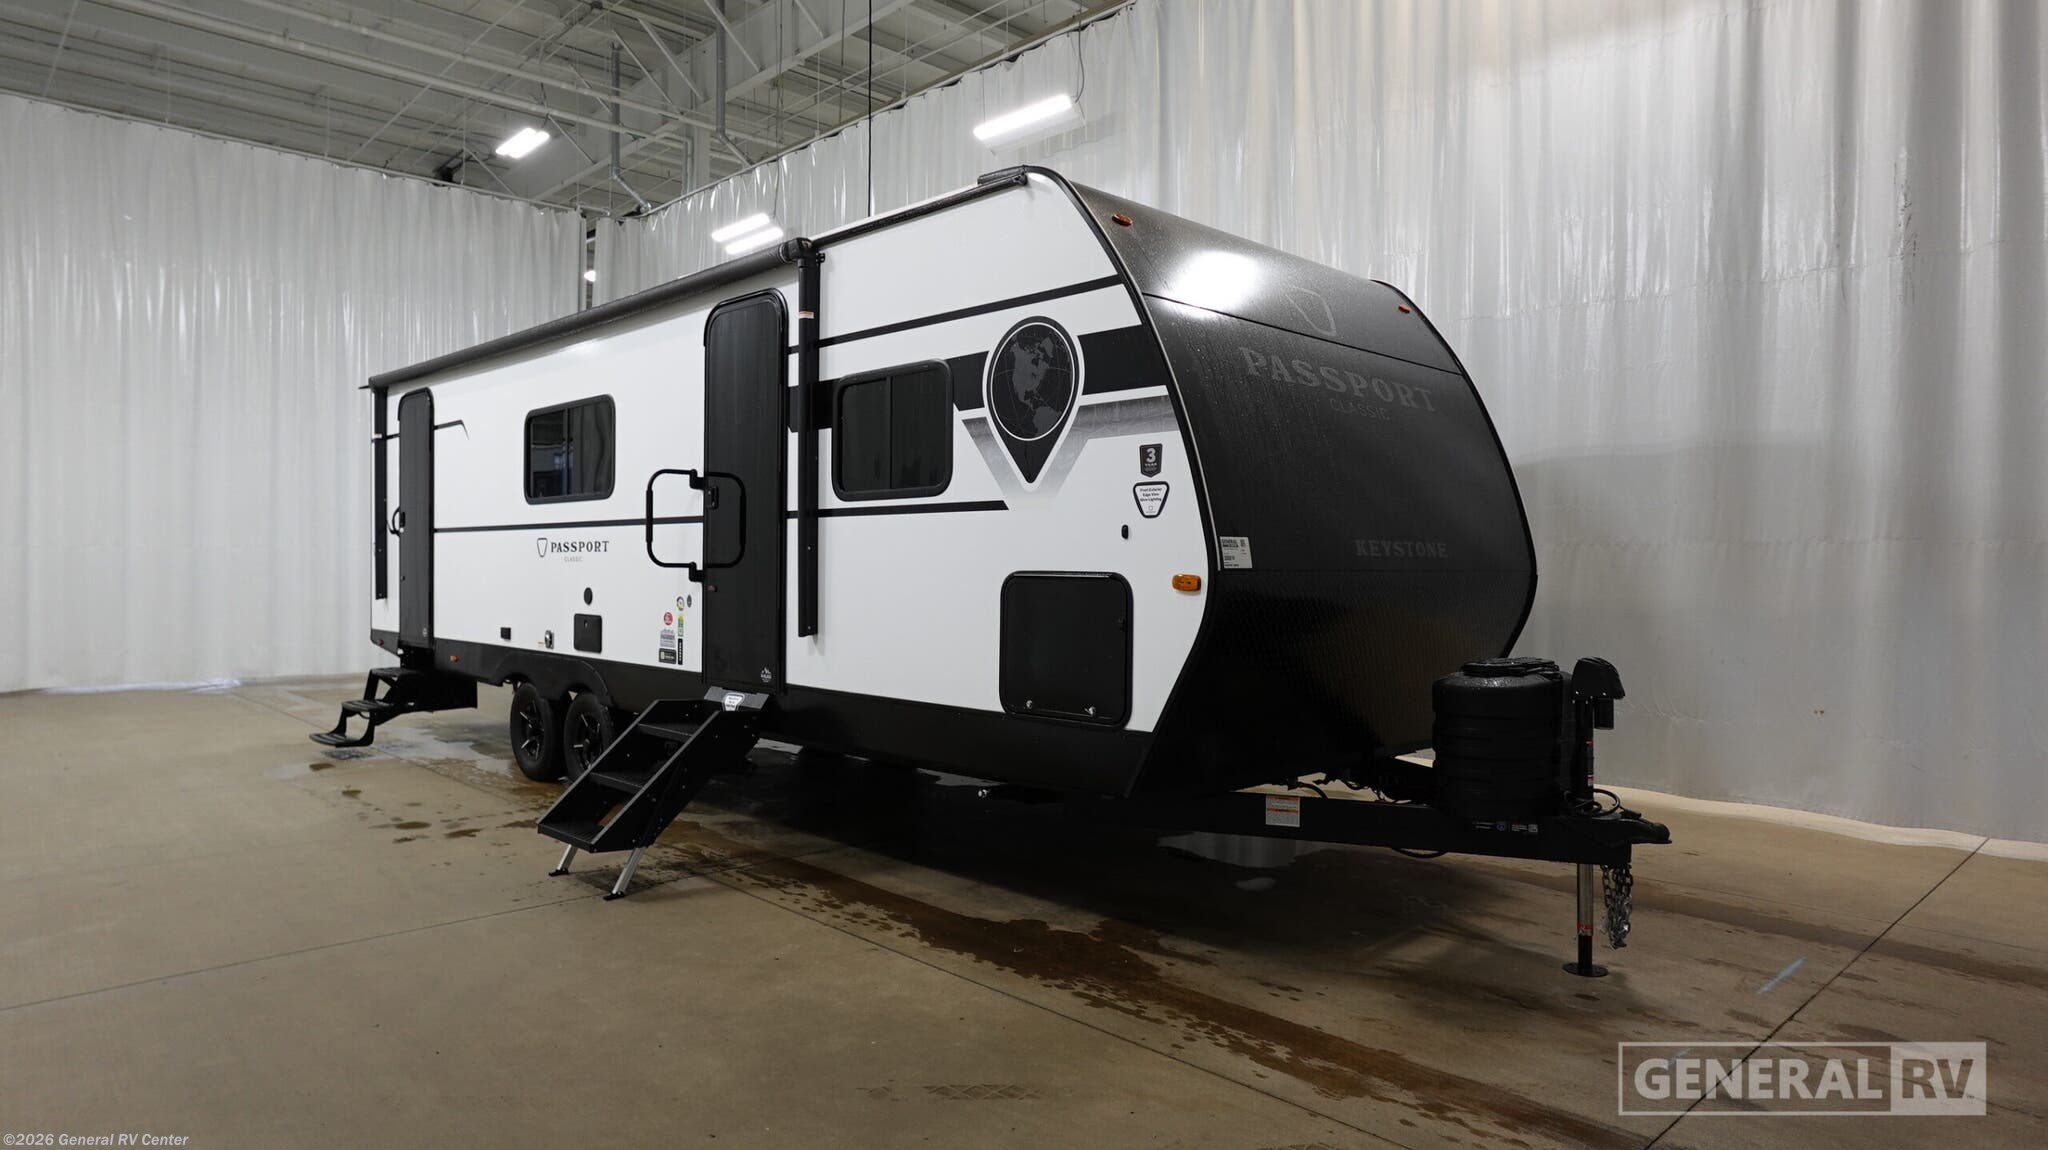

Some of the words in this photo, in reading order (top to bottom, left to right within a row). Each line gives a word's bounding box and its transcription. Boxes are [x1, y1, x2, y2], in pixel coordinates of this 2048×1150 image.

[1237, 346, 1436, 412] PASSPORT
[1329, 398, 1391, 420] CLASSIC
[1146, 448, 1156, 463] 3
[551, 541, 610, 553] PASSPORT
[1354, 539, 1449, 558] KEYSTONE
